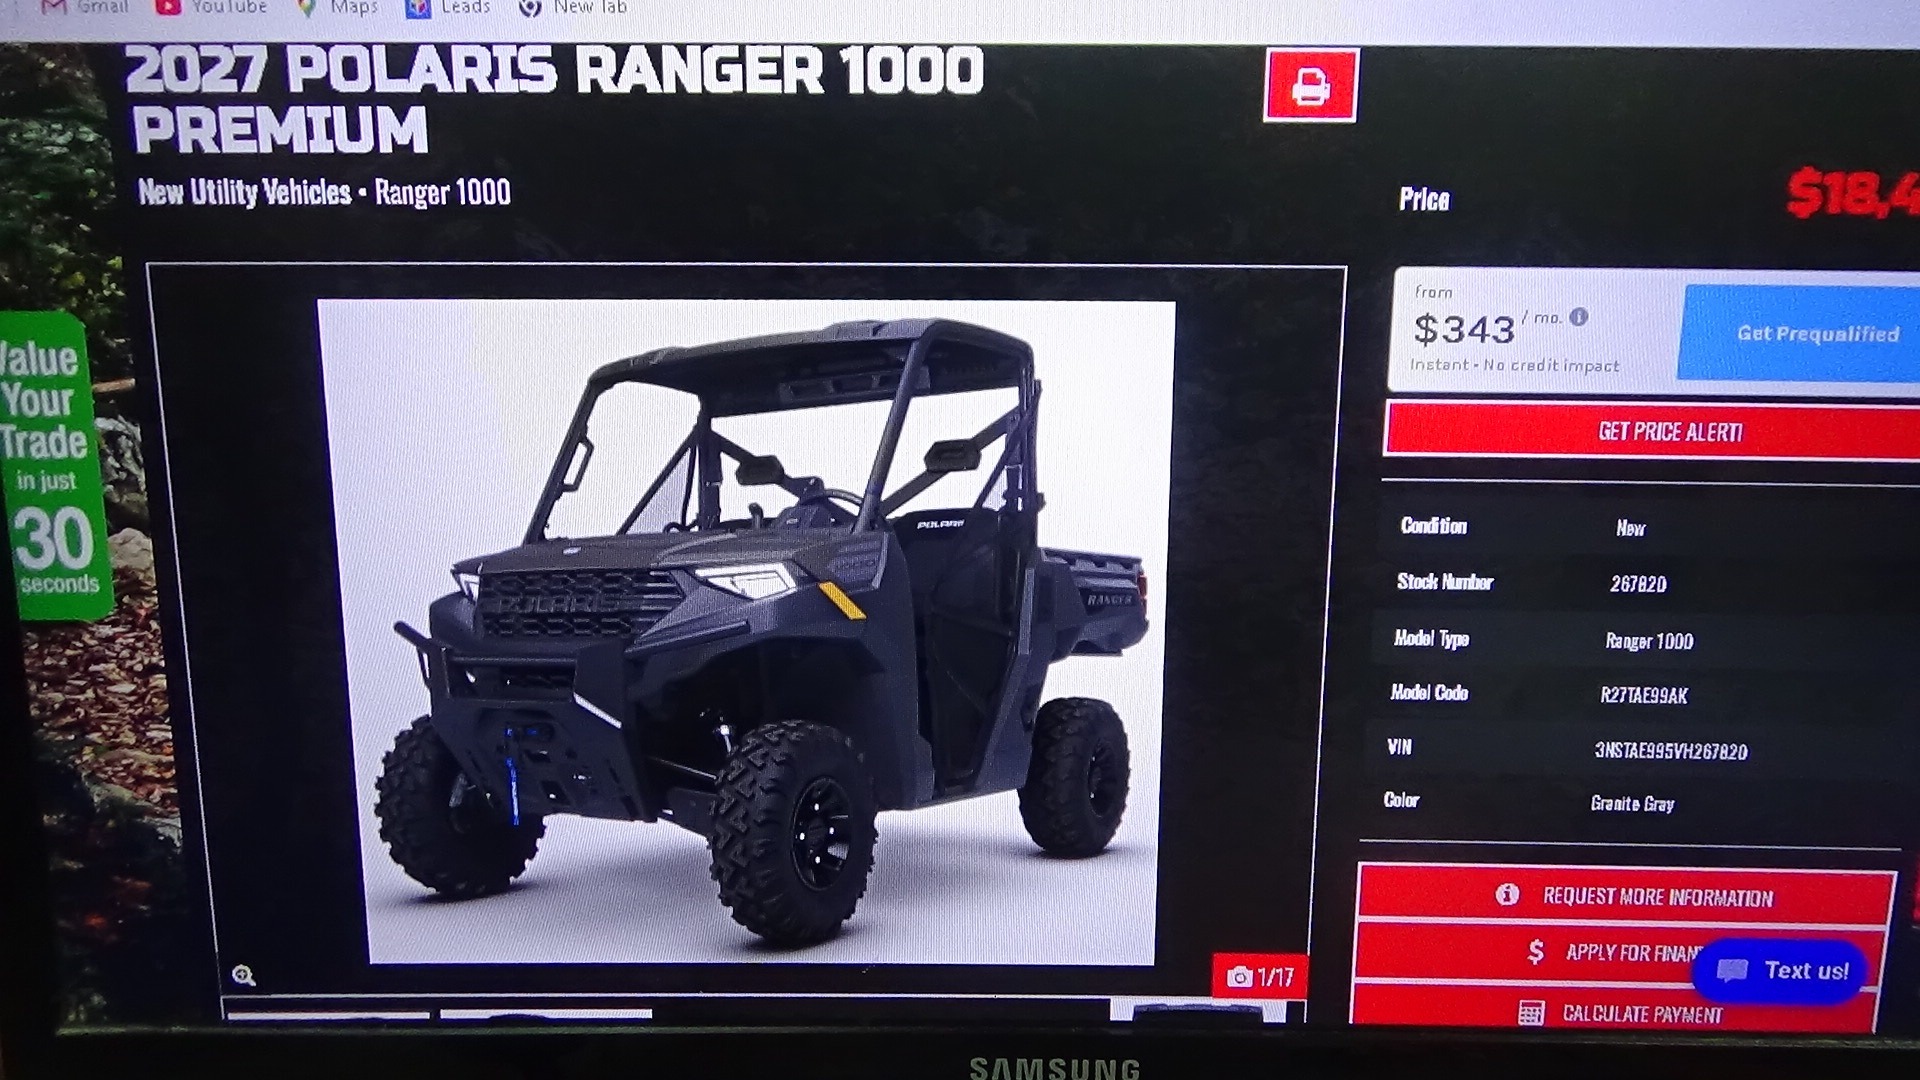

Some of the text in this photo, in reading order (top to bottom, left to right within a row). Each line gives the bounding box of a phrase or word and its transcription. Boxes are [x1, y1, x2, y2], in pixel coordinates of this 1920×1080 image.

[77, 0, 129, 14] Gmail
[192, 0, 267, 14] YouTube
[332, 0, 378, 17] Maps
[442, 0, 491, 14] Leads
[555, 0, 594, 14] New
[125, 44, 985, 94] 2027 POLARIS RANGER 1000
[132, 105, 429, 153] PREMIUM
[138, 178, 512, 210] New Utility Vehicles Ranger 1000
[1399, 186, 1451, 212] Price
[1415, 284, 1453, 299] from
[1414, 312, 1515, 347] $343
[1534, 313, 1562, 325] mo.
[1738, 324, 1901, 346] Get Prequalified
[1410, 357, 1620, 376] Instant No credit impact
[0, 381, 75, 418] Your
[1599, 420, 1631, 441] GET
[1634, 421, 1682, 442] PRICE
[0, 424, 88, 459] Trade
[17, 470, 77, 493] in just
[1401, 516, 1468, 536] Condition
[1616, 519, 1646, 538] New
[13, 506, 94, 571] 30
[20, 574, 100, 594] seconds
[1397, 573, 1495, 593] Stock Number
[1610, 575, 1667, 594] 267820
[1394, 629, 1470, 651] Model Type
[1606, 632, 1694, 652] Ranger 1000
[1390, 683, 1468, 702] Model Code
[1600, 686, 1689, 705] R27TAE99AK
[1387, 738, 1412, 756] VIN
[1384, 791, 1420, 808] Color
[1590, 794, 1675, 815] Granite Gray
[1544, 886, 1774, 909] REQUEST MORE INFORMATION
[1566, 943, 1617, 962] APPLY
[1620, 944, 1651, 962] FOR
[1654, 945, 1704, 963] FINAN
[1257, 967, 1295, 988] 1/17
[1765, 960, 1850, 980] Text us!
[1563, 1004, 1724, 1024] CALCULATE PAYMENT
[970, 1057, 1140, 1080] SAMSUNG
